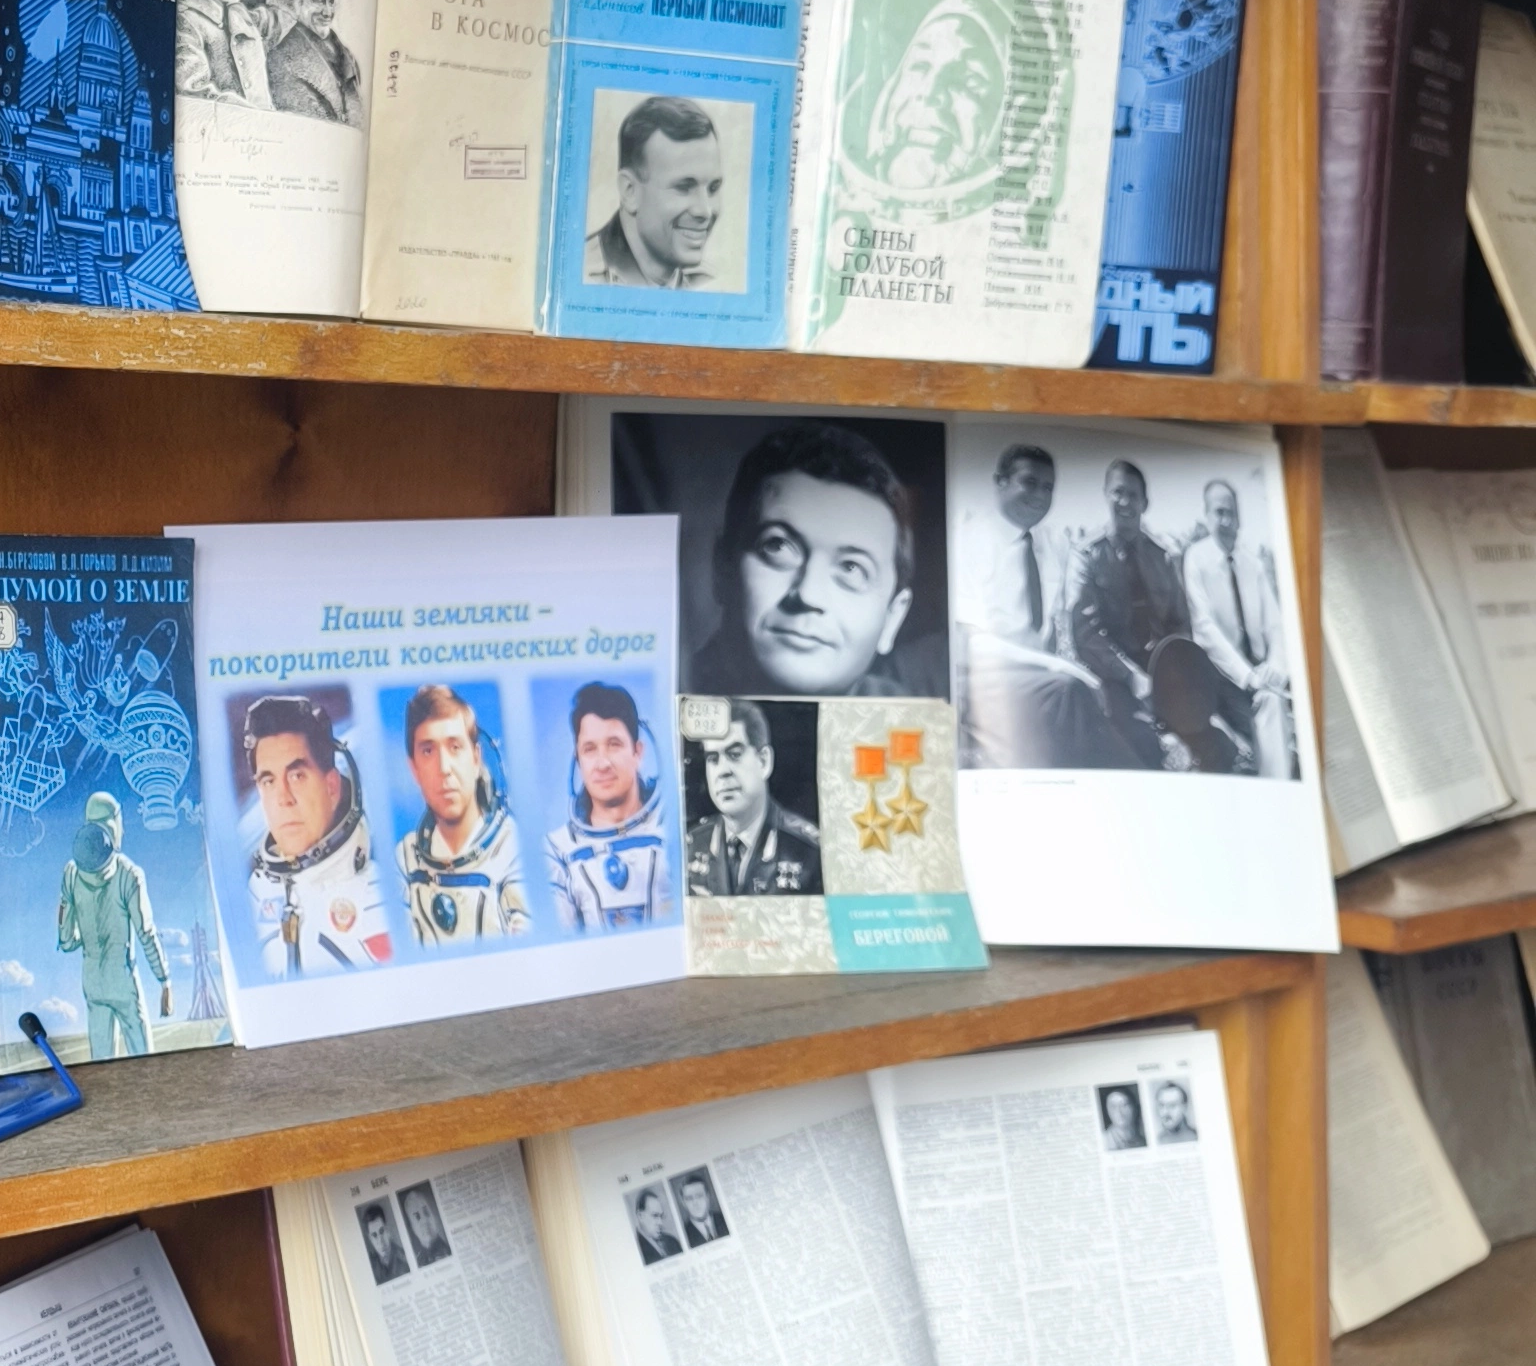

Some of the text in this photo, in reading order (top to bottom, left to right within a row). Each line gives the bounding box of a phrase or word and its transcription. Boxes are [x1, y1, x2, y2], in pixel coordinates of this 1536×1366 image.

[431, 12, 552, 48] В КОСМОС
[844, 227, 916, 253] СЫНЫ
[841, 251, 945, 281] ГОЛУБОЙ
[838, 276, 954, 305] ПЛАНЕТЫ
[90, 578, 107, 602] О
[114, 578, 190, 603] ЗЕМЛЕ
[321, 604, 404, 632] Наши
[413, 601, 530, 629] земляки
[210, 627, 657, 681] покорители космических дорог
[854, 924, 949, 947] БЕРЕГОВОЙ
